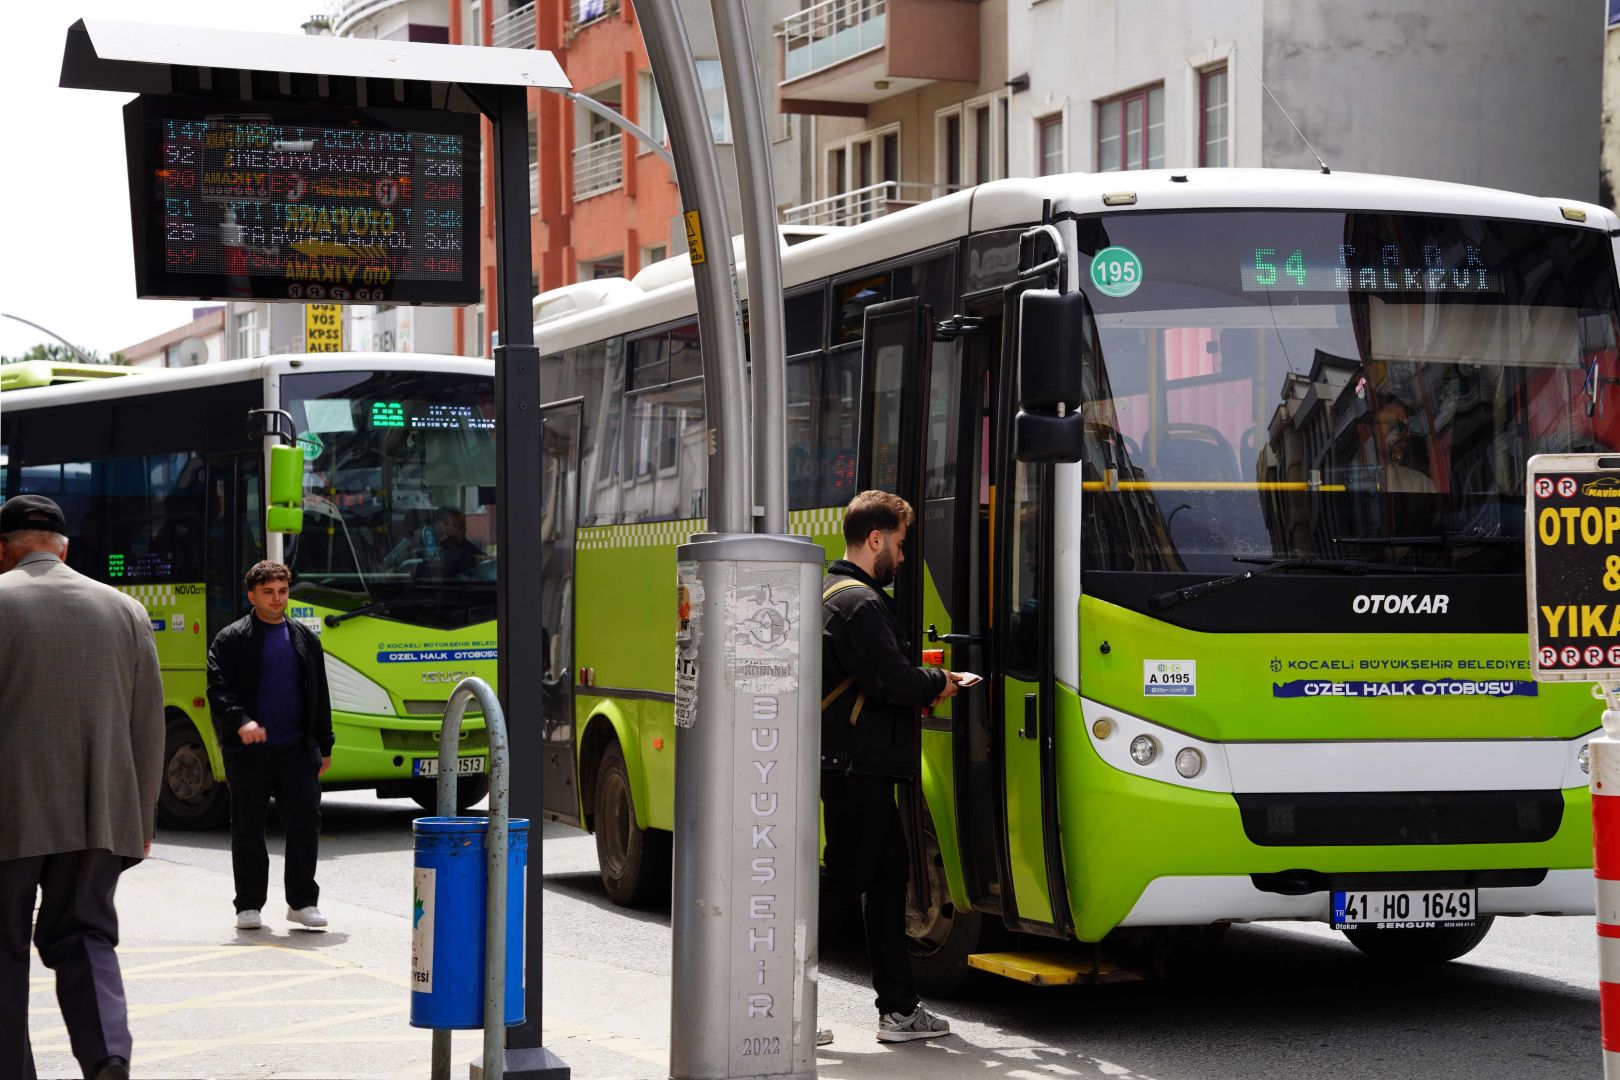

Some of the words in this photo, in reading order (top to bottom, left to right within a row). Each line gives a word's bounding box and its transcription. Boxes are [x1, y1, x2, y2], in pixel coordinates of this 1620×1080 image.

[1096, 261, 1136, 283] 195
[1256, 248, 1307, 286] 54
[309, 328, 339, 340] KPSS
[1352, 595, 1450, 614] OTOKAR
[389, 652, 418, 662] ÖZEL
[420, 652, 448, 661] HALK
[1288, 660, 1355, 671] KOCAELİ
[1359, 659, 1453, 672] BÜYÜKŞEHİR
[1149, 674, 1158, 683] A
[1162, 674, 1190, 683] 0195
[1303, 682, 1358, 696] ÖZEL
[1363, 682, 1416, 696] HALK
[1421, 681, 1514, 695] OTOBÜSÜ
[420, 760, 432, 774] 41
[458, 758, 481, 773] 1513
[1335, 909, 1345, 917] TR
[1345, 894, 1368, 920] 41
[1382, 893, 1410, 920] HO
[1422, 892, 1471, 919] 1649
[1335, 923, 1358, 931] Otokar
[741, 1036, 780, 1057] 2022
